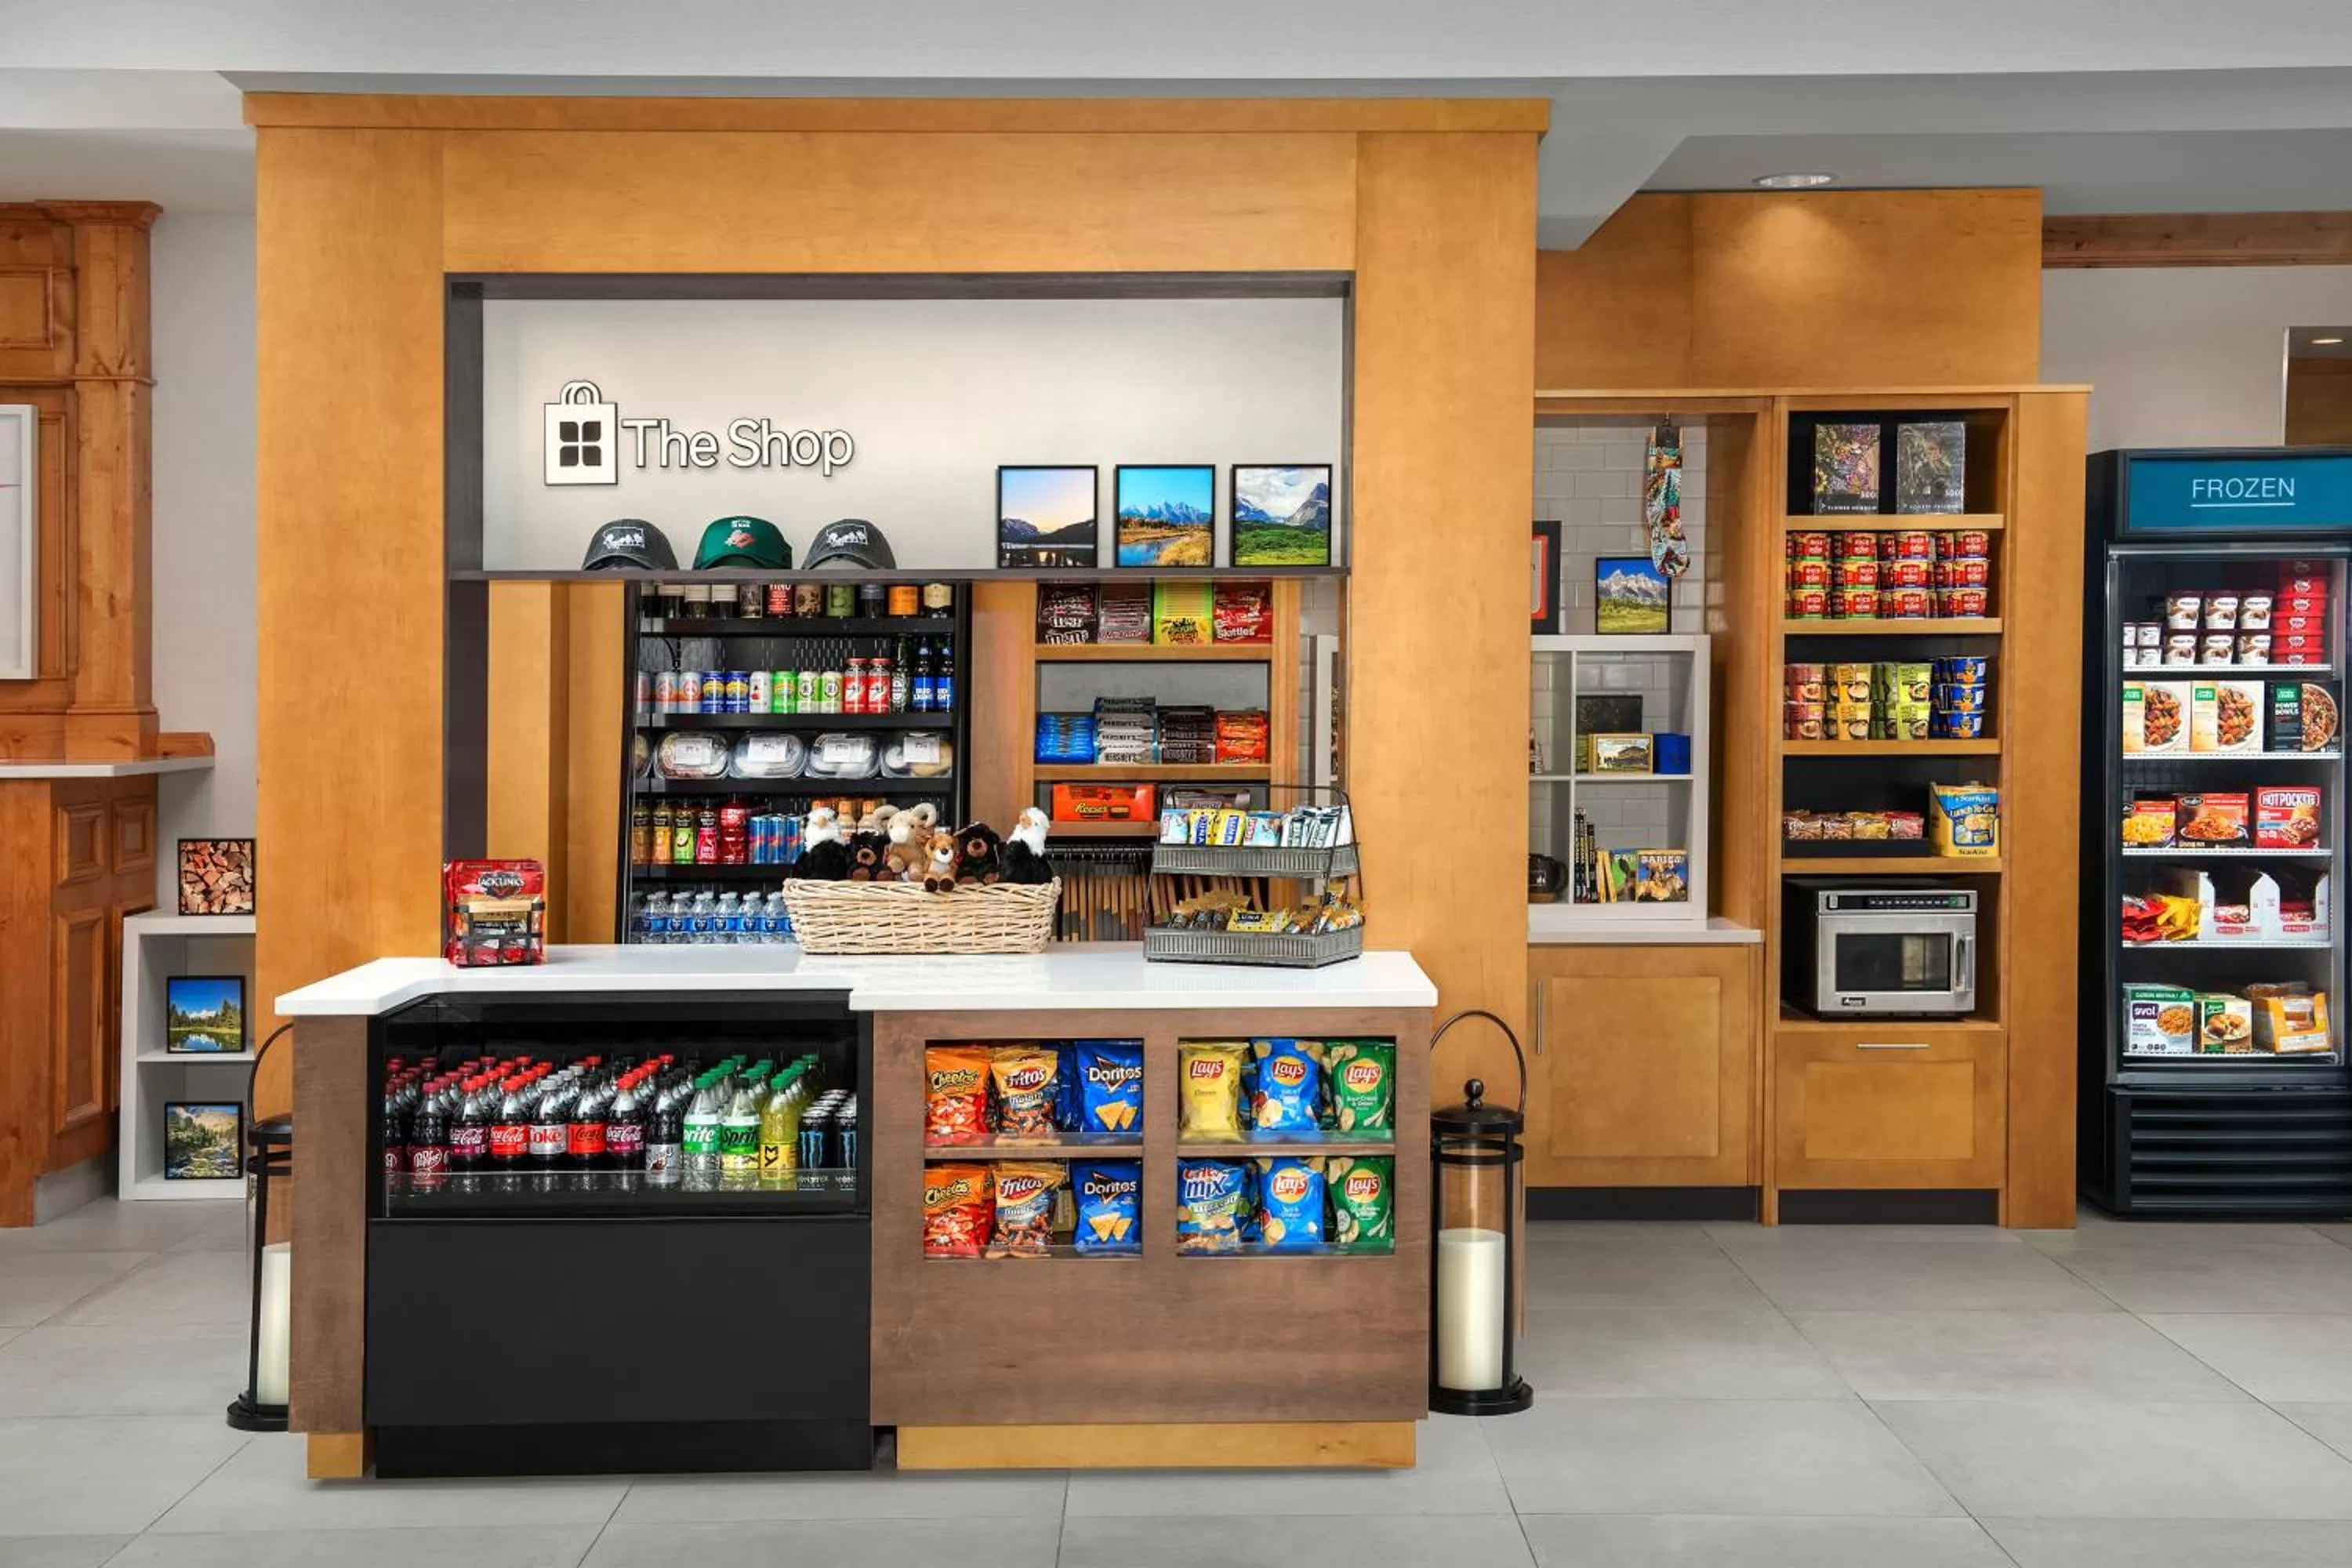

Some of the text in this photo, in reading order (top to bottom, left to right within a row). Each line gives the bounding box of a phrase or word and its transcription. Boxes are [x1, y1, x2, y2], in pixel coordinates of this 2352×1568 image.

[622, 417, 855, 477] The Shop
[2192, 477, 2296, 499] FROZEN
[2263, 793, 2278, 806] HOT
[2279, 793, 2316, 806] POCKETS
[931, 1069, 978, 1091] Cheetos
[1004, 1067, 1046, 1087] Fritos
[1089, 1066, 1142, 1082] Doritos
[724, 1127, 757, 1147] Sprit
[924, 1179, 969, 1205] Cheetos
[1000, 1178, 1042, 1197] Fritos
[1084, 1181, 1137, 1195] Doritos
